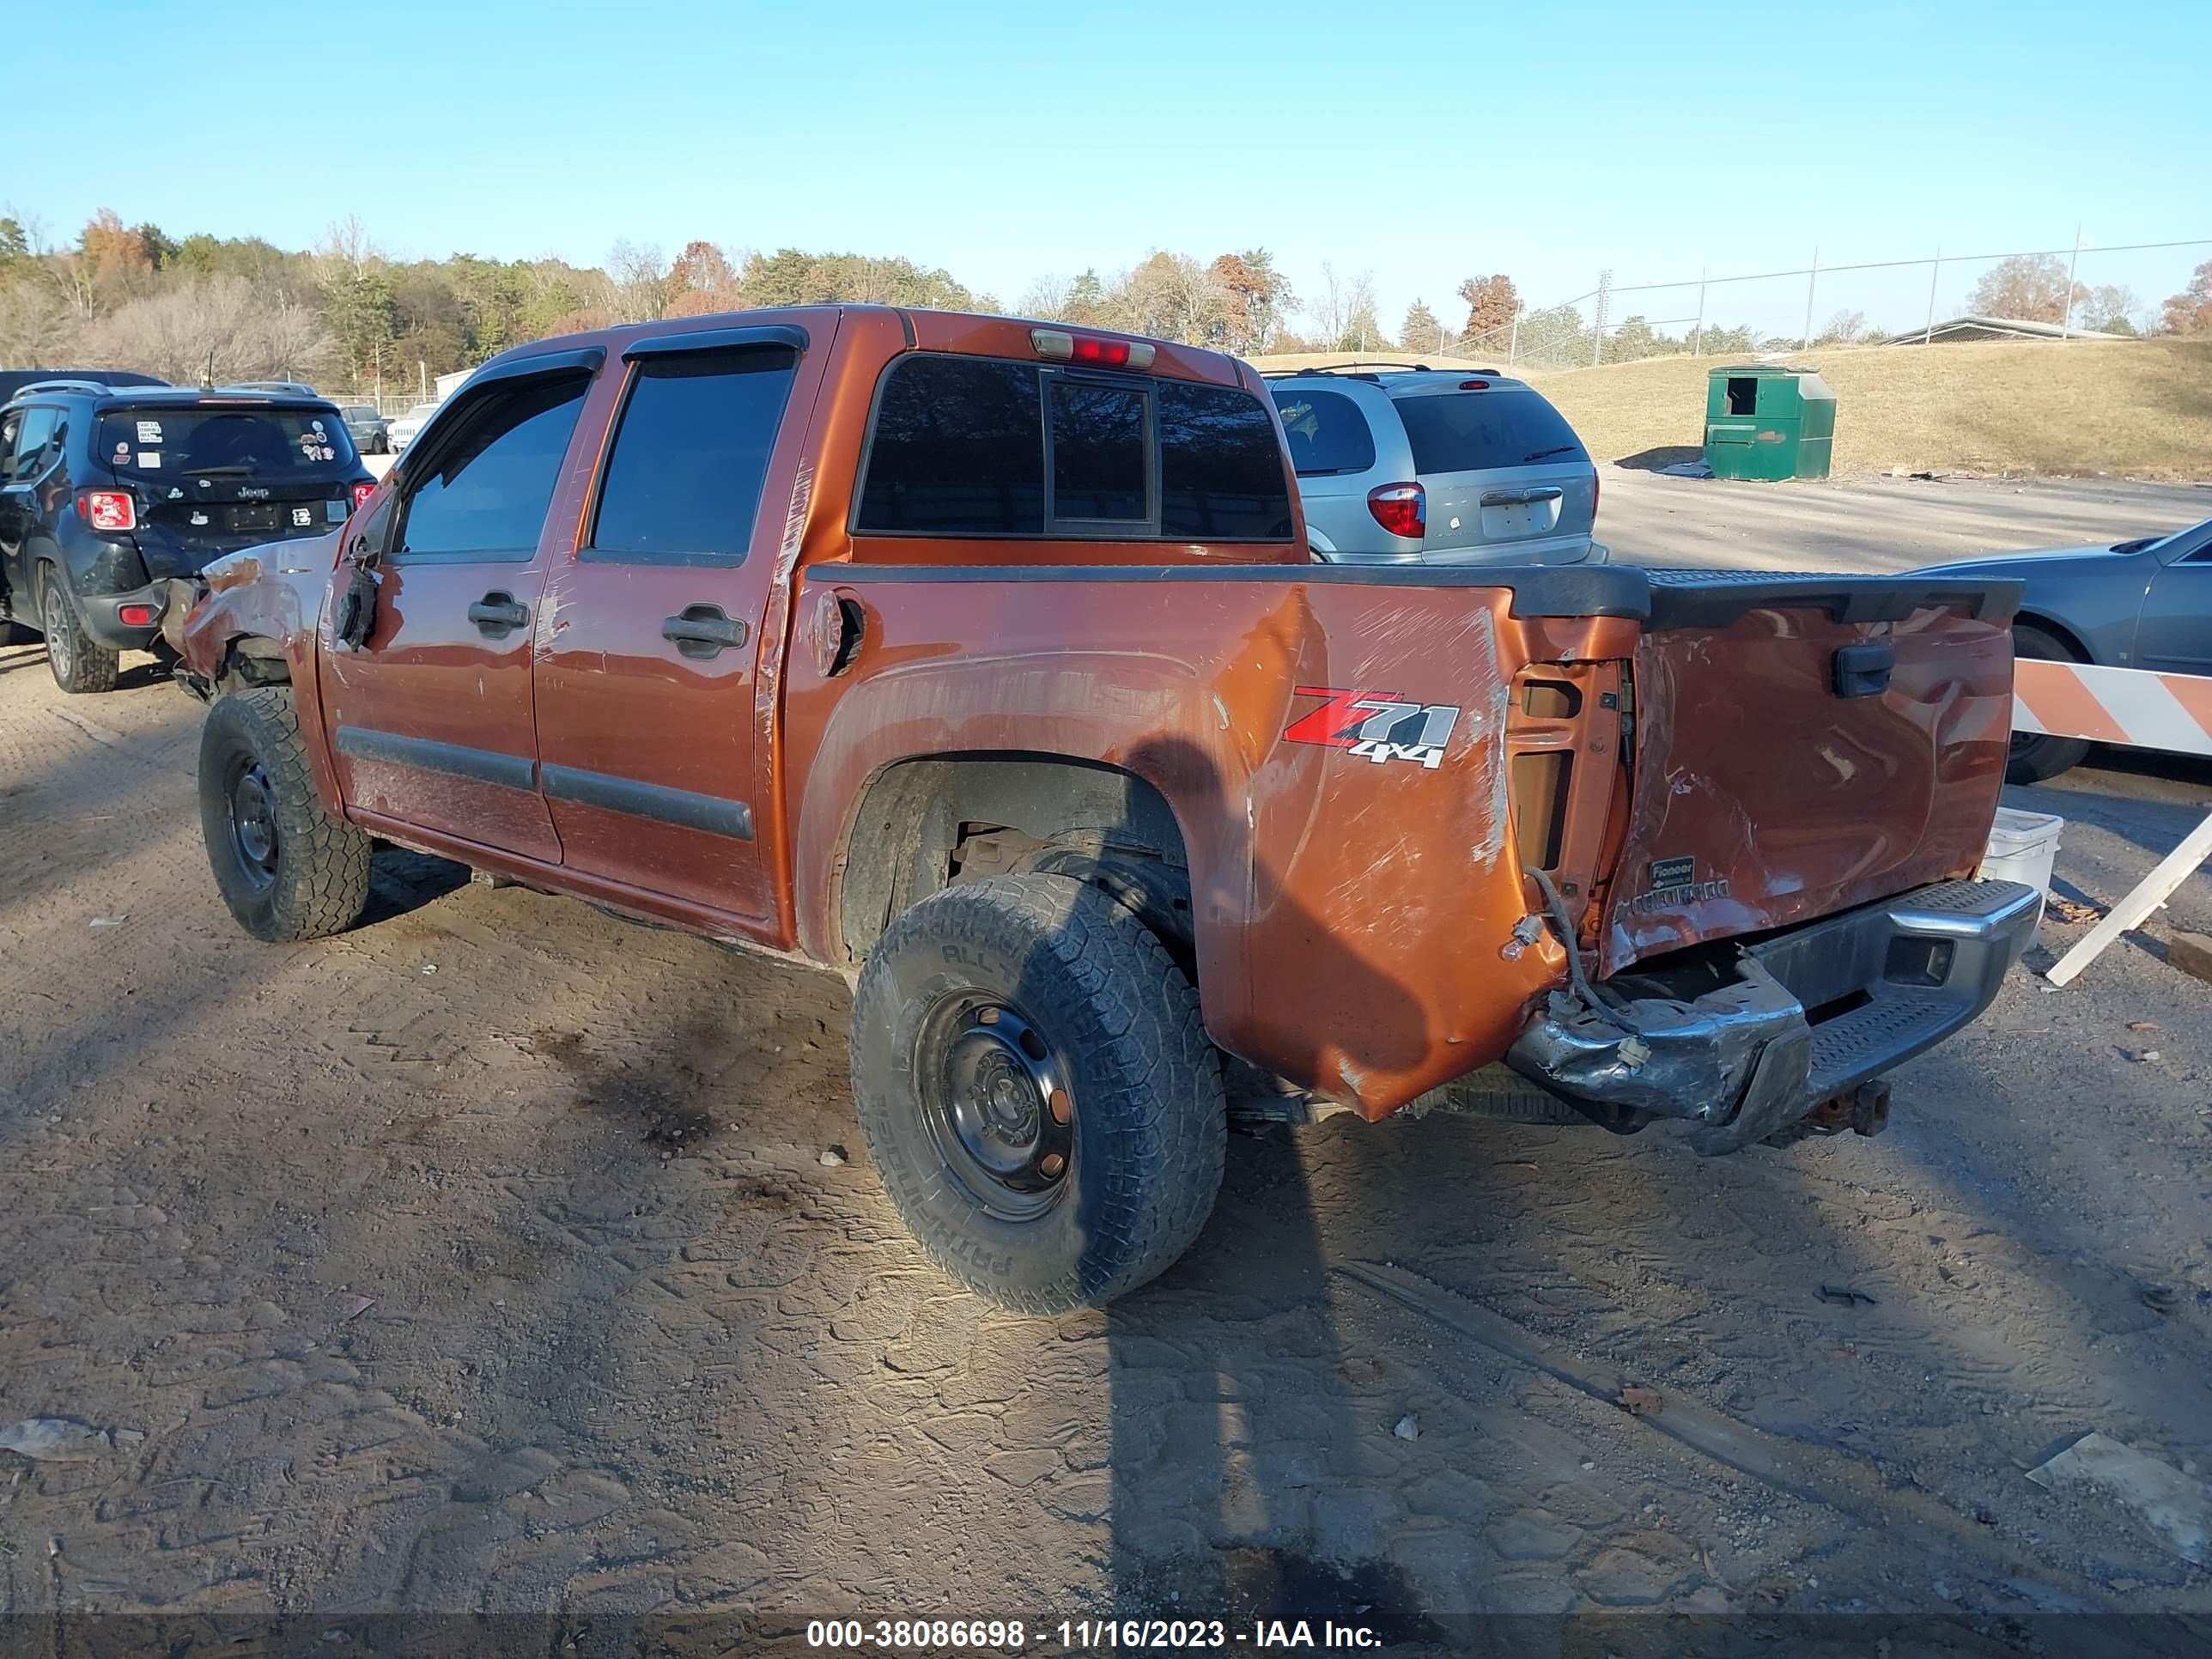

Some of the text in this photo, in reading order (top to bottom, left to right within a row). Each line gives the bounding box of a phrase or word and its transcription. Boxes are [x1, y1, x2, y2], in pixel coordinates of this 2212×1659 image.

[237, 486, 270, 499] Jeep
[1281, 685, 1462, 749] Z71
[1652, 864, 1692, 878] Pioneer
[1632, 879, 1731, 915] COLORADO
[941, 944, 994, 974] ALL
